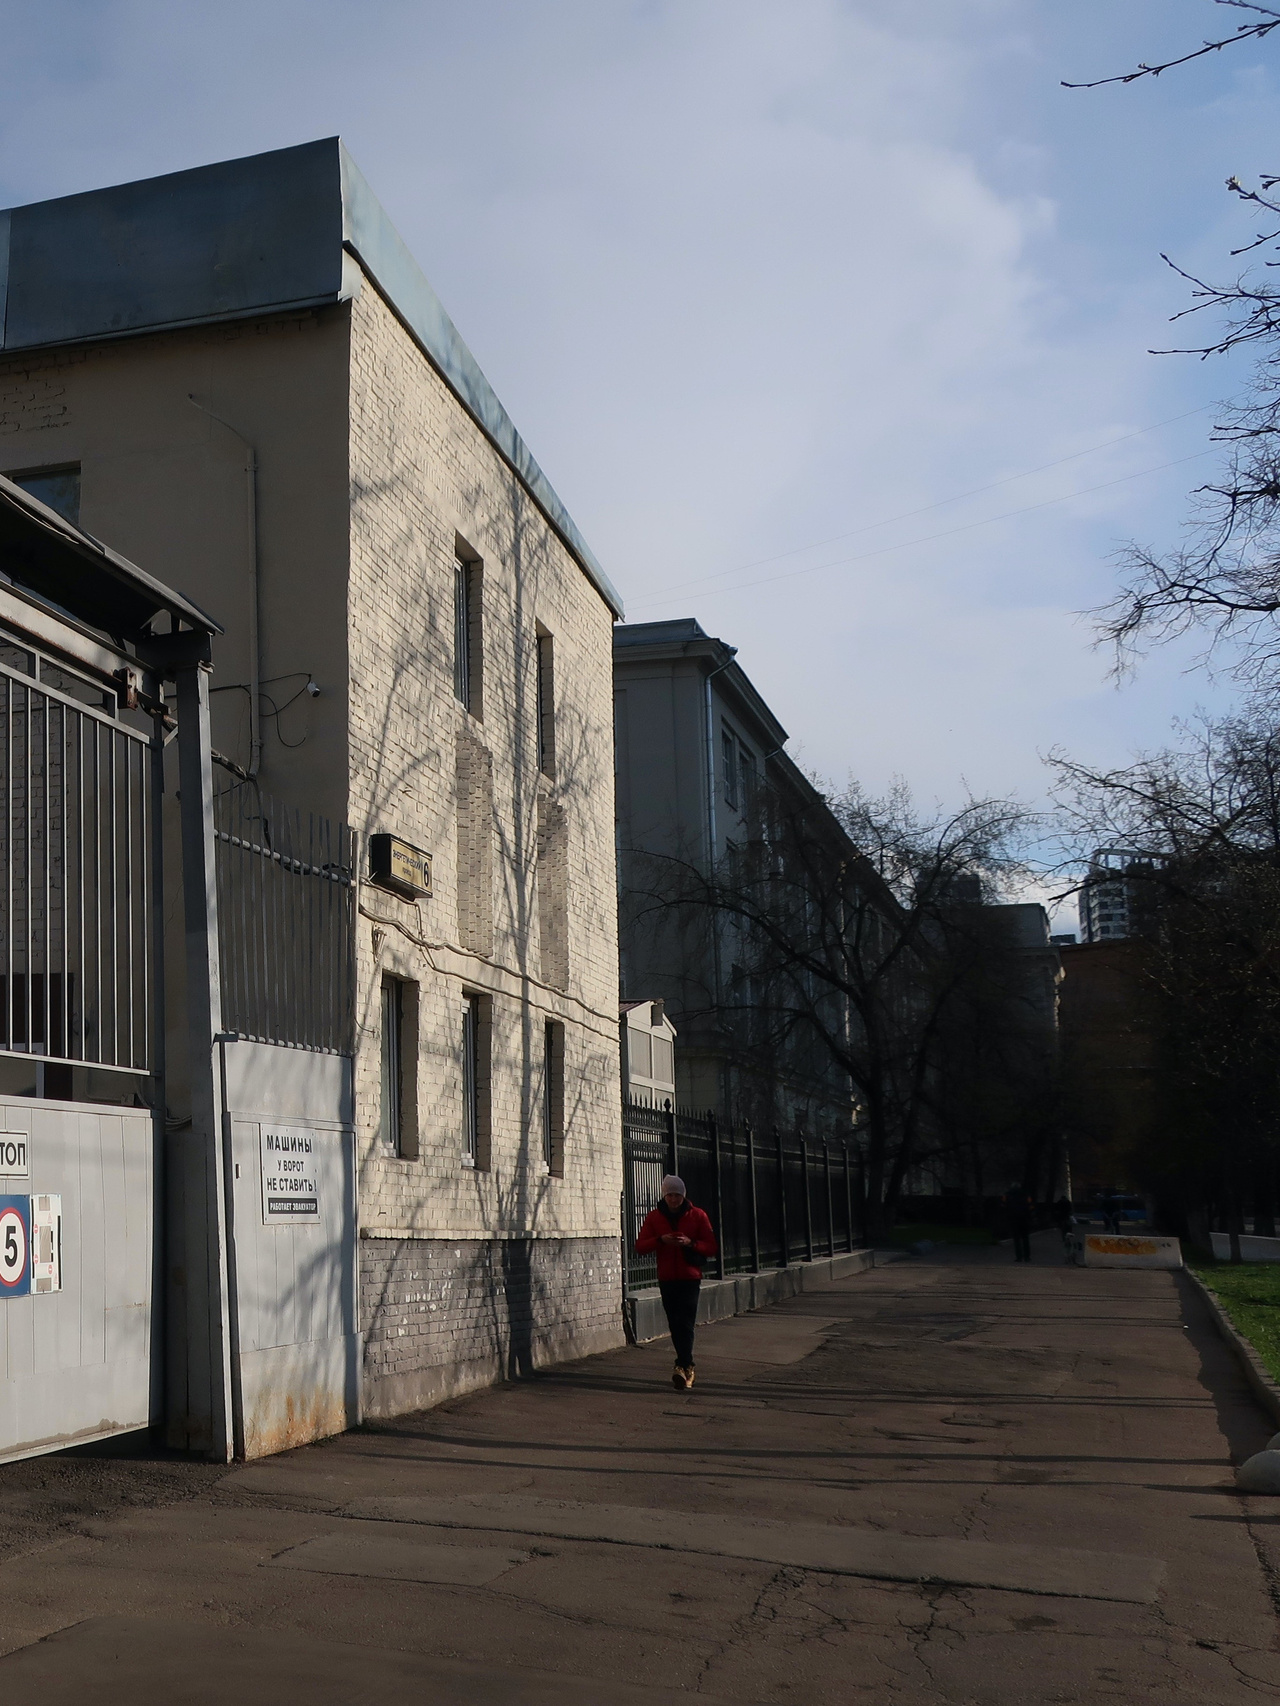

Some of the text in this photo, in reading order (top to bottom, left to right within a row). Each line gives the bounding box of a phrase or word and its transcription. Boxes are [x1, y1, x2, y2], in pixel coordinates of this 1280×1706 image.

[424, 862, 429, 887] 6
[267, 1135, 312, 1153] МАШИНЫ
[277, 1160, 304, 1172] У ВОРОТ
[267, 1178, 277, 1191] НЕ
[270, 1203, 292, 1211] РАБОТАЕТ
[4, 1226, 18, 1267] 5
